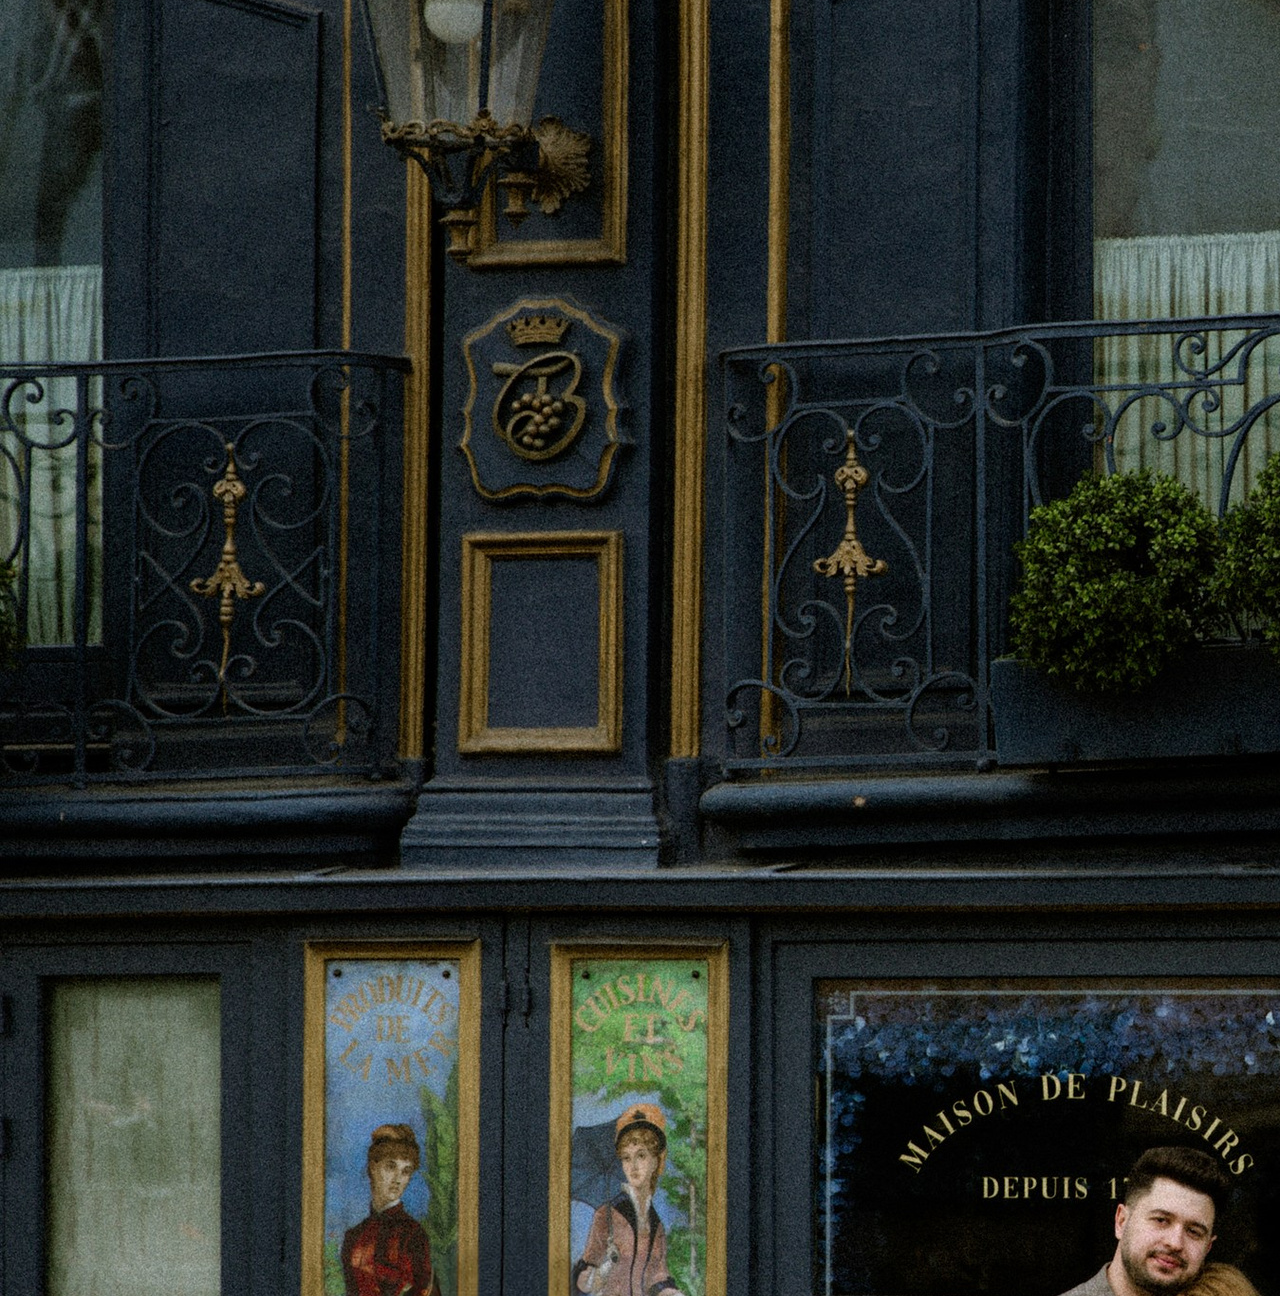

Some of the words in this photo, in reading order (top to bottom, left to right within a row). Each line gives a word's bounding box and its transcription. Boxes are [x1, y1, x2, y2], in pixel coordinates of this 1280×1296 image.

[375, 1014, 412, 1044] DE
[622, 1013, 661, 1044] ET
[338, 1037, 374, 1083] LA
[384, 1030, 457, 1086] MER
[604, 1044, 684, 1082] VINS
[898, 1079, 1019, 1175] MAISON
[1041, 1072, 1087, 1102] DE
[1107, 1075, 1257, 1176] PLAISIRS
[982, 1176, 1088, 1200] DEPUIS
